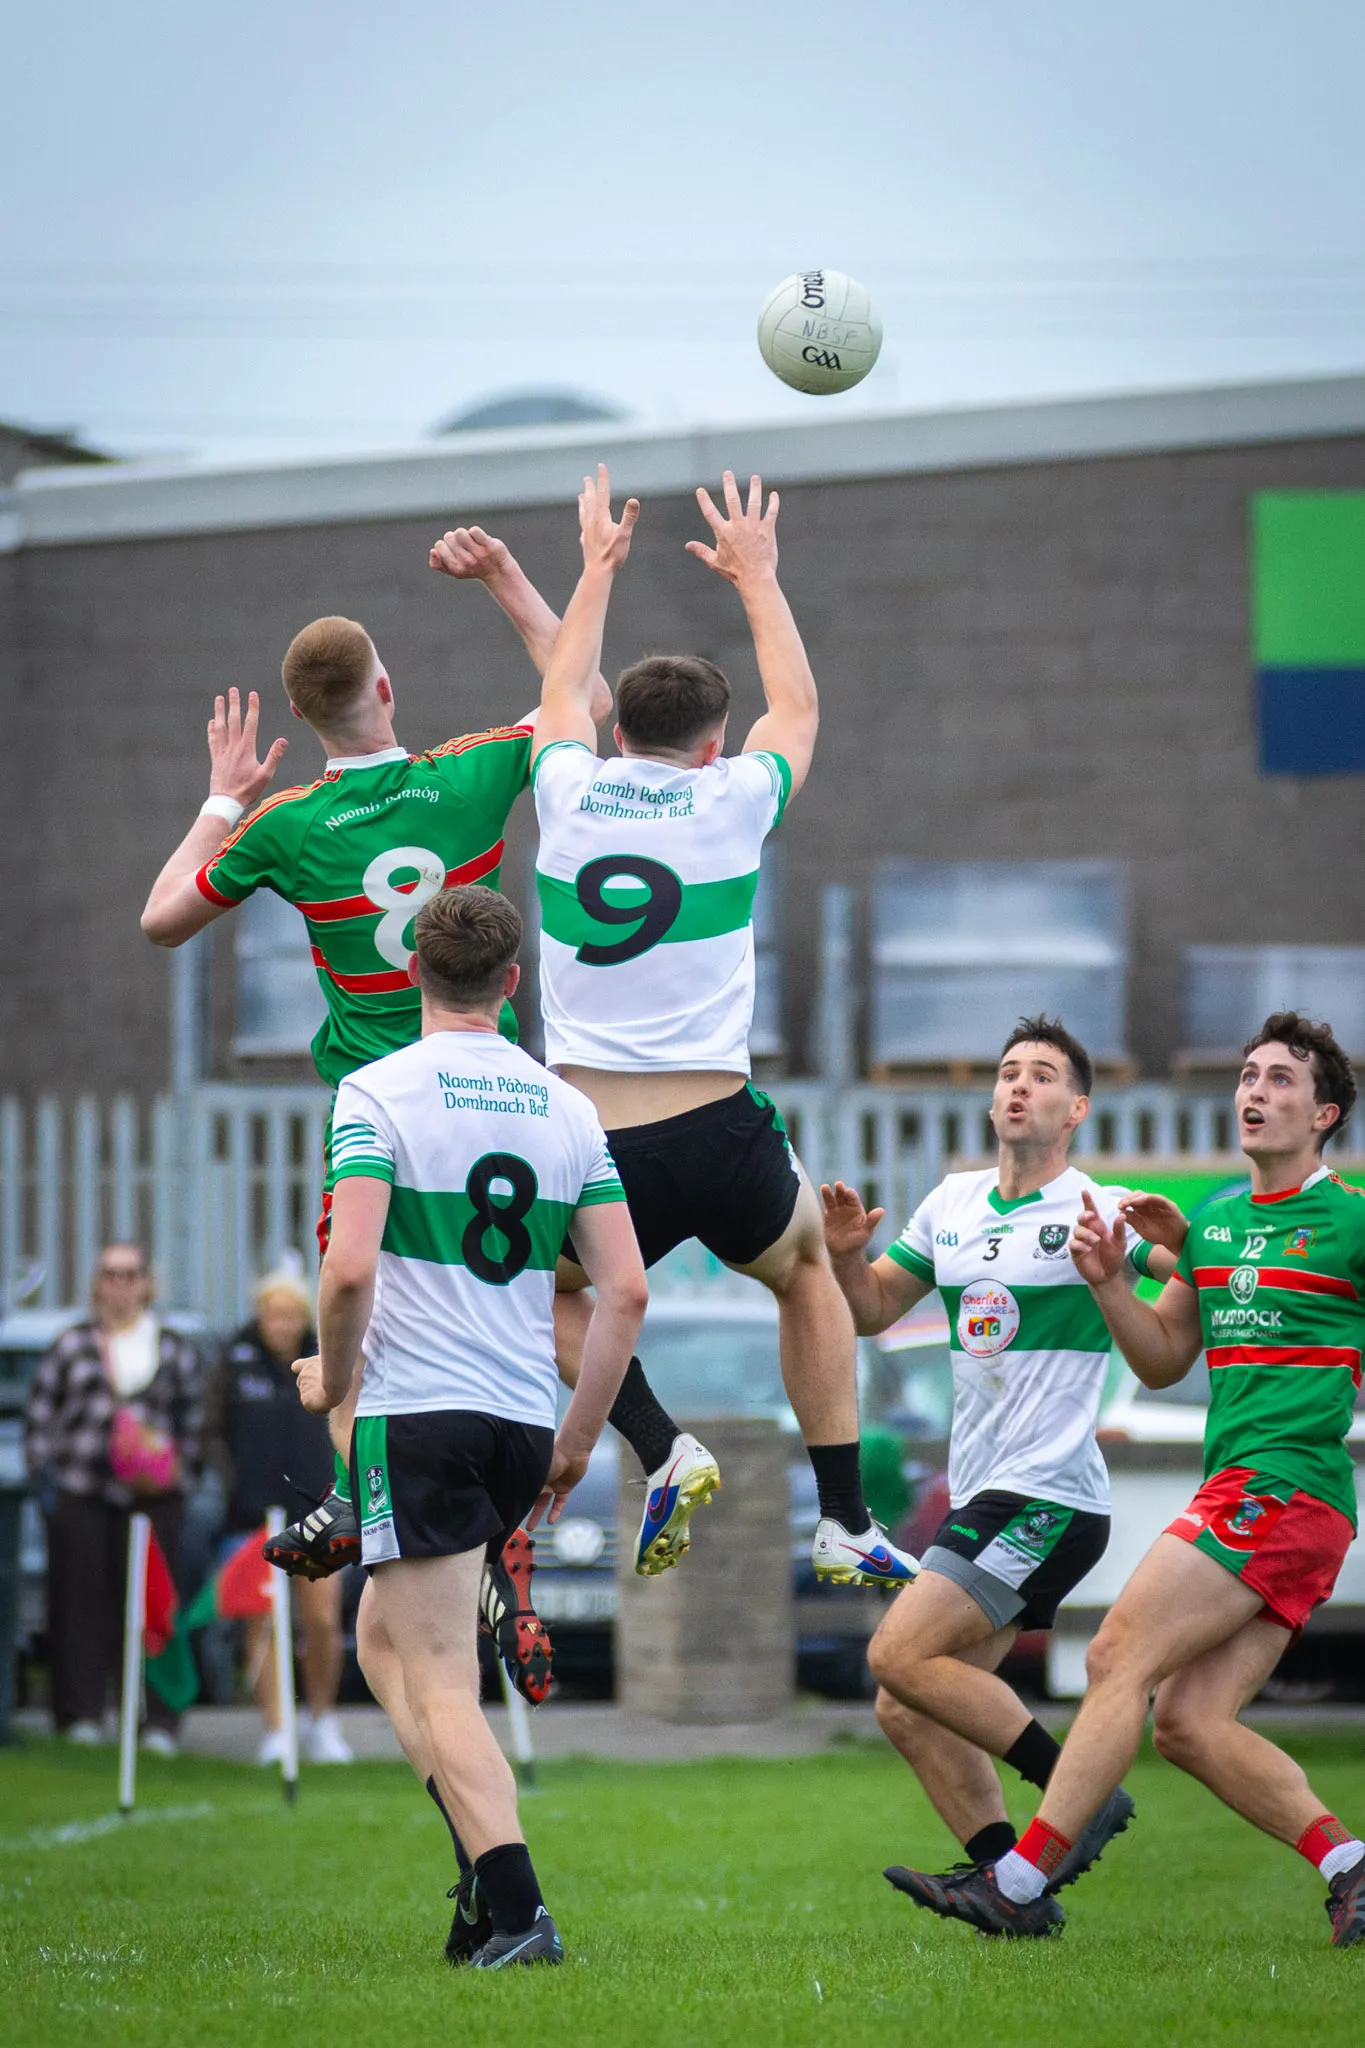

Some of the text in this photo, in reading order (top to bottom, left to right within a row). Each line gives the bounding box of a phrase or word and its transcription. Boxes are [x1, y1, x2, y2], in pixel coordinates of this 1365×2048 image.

[592, 781, 635, 800] aomh
[669, 801, 695, 818] Bat
[362, 846, 446, 971] 8
[575, 853, 683, 967] 9
[437, 1071, 493, 1092] Naomh
[444, 1091, 549, 1118] Domhnach Bat
[461, 1151, 538, 1287] 8
[982, 1237, 1003, 1261] 3
[1239, 1235, 1267, 1259] 12
